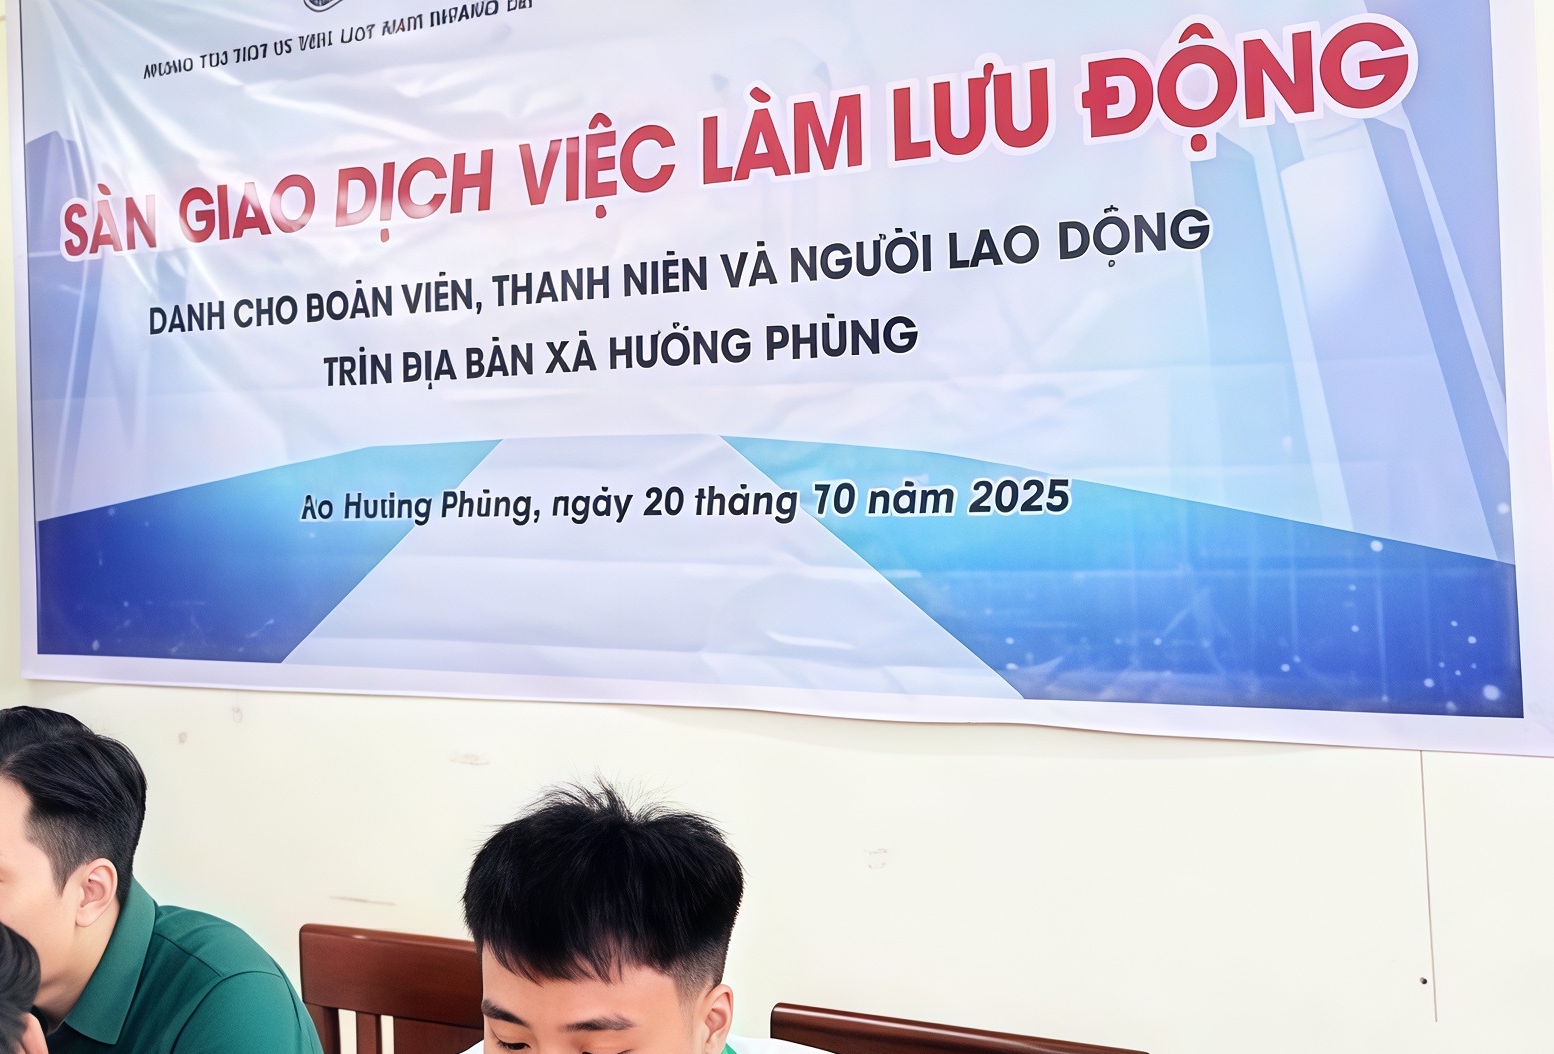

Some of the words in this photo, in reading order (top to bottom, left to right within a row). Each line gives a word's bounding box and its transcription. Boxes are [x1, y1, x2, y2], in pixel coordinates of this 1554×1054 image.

[64, 184, 156, 257] SÀN
[180, 174, 316, 243] GIAO
[336, 148, 493, 243] DỊCH
[519, 112, 676, 219] VIỆC
[703, 87, 863, 185] LÀM
[893, 62, 1050, 162] LƯU
[1081, 22, 1409, 153] ĐỘNG
[234, 291, 298, 329] CHO
[492, 264, 610, 308] THANH
[948, 225, 1040, 270] LAO
[644, 486, 685, 516] 20
[968, 479, 1070, 514] 2025
